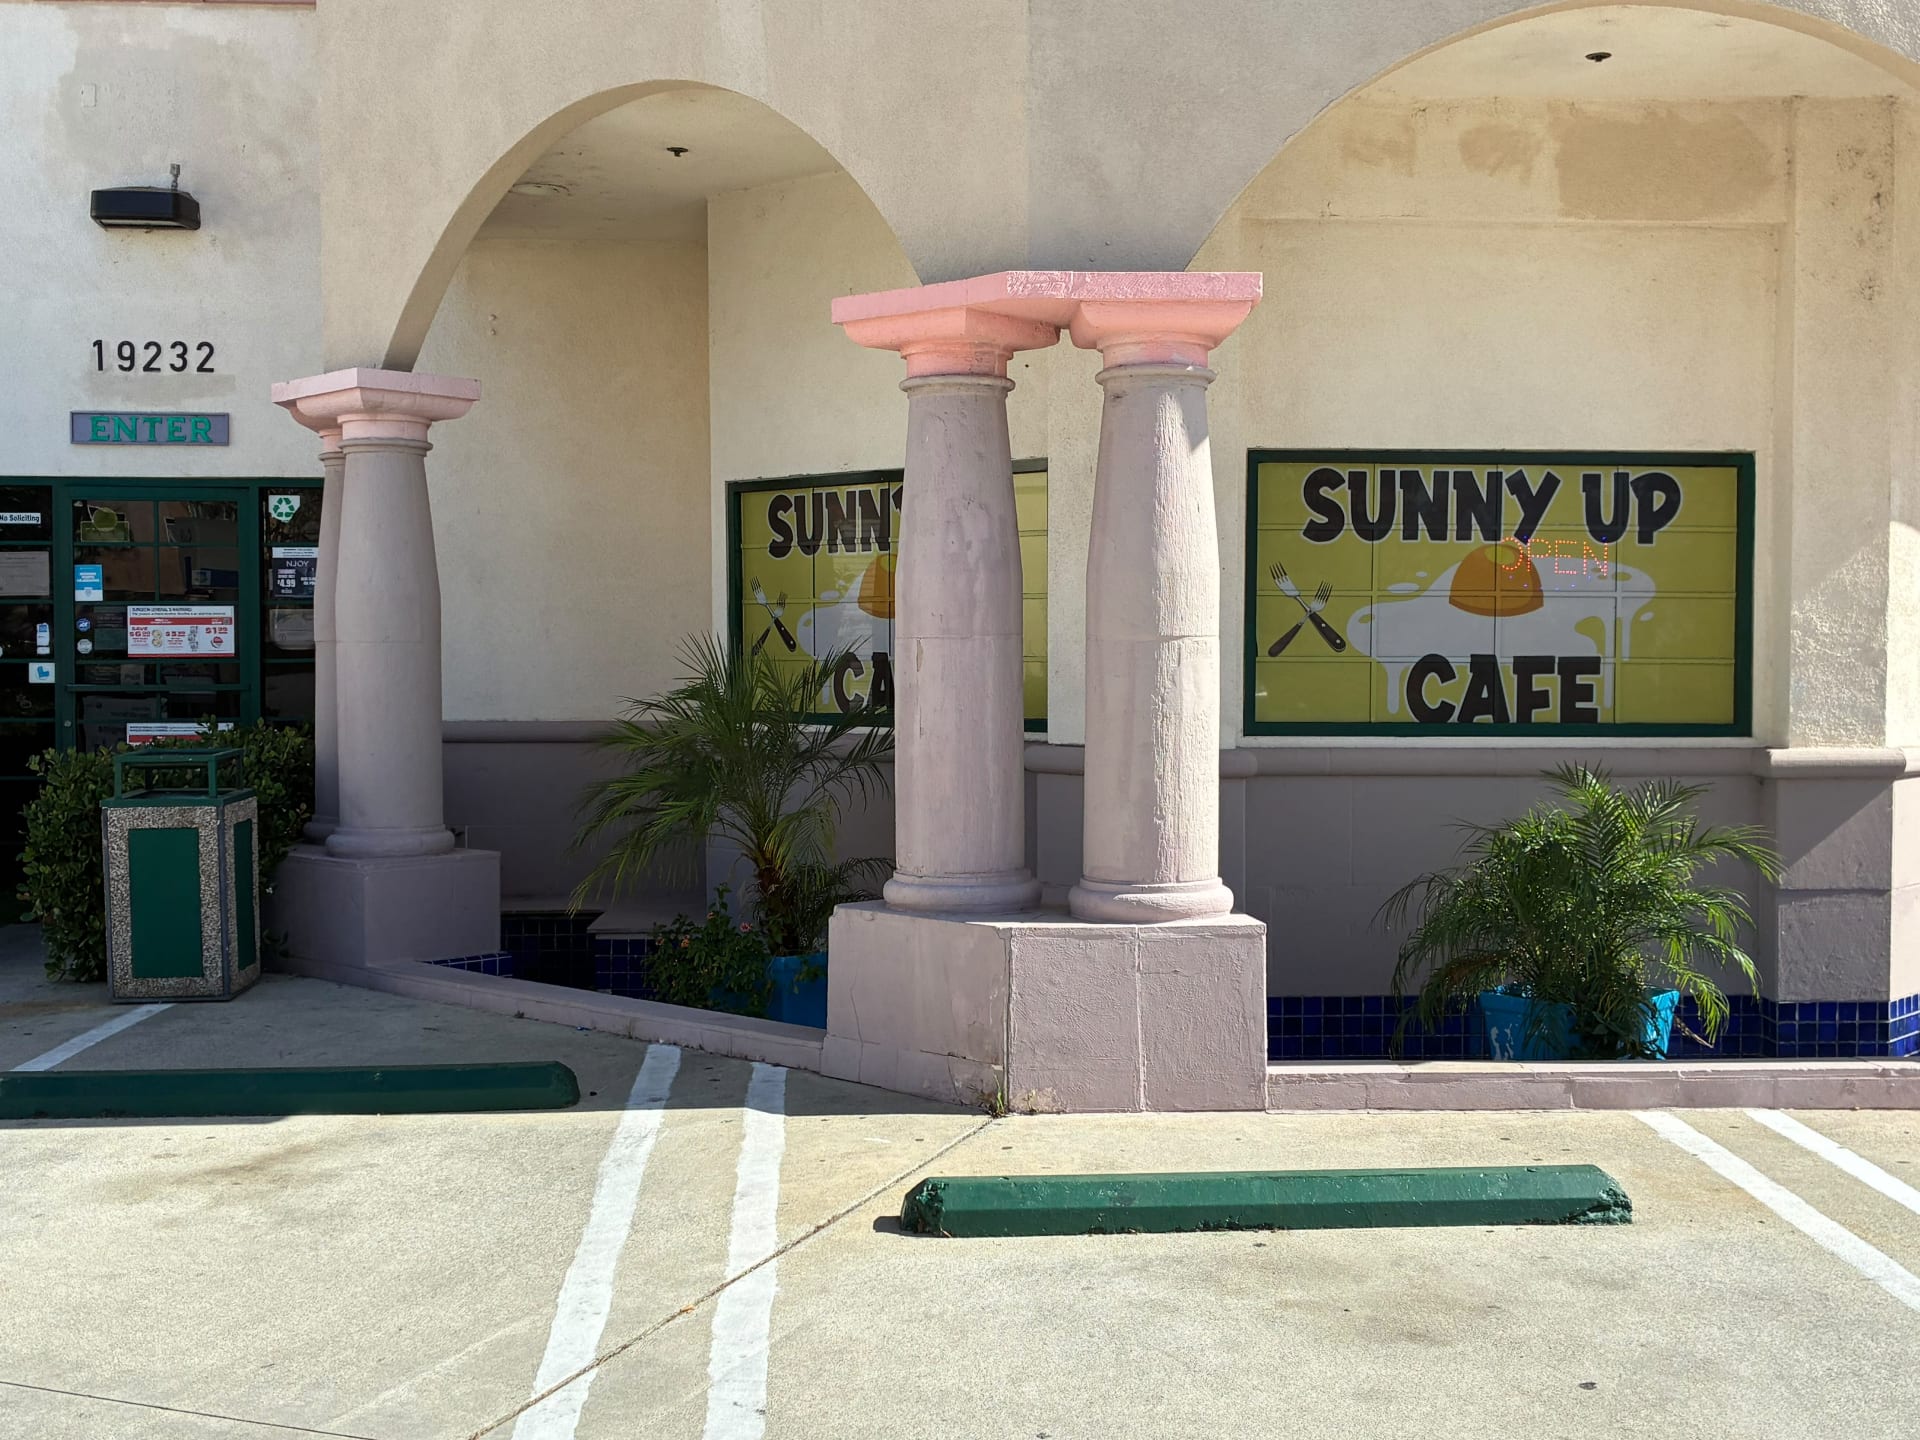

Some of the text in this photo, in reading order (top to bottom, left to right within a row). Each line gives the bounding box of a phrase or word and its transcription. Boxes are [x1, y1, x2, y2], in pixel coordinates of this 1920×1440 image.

[92, 339, 215, 373] 19232
[90, 415, 213, 443] ENTER
[9, 514, 40, 522] Soliciting
[767, 485, 903, 559] SUNN
[1303, 467, 1682, 545] SUNNY UP
[1500, 536, 1609, 577] OPEN
[833, 651, 896, 714] CA
[1405, 653, 1601, 724] CAFE
